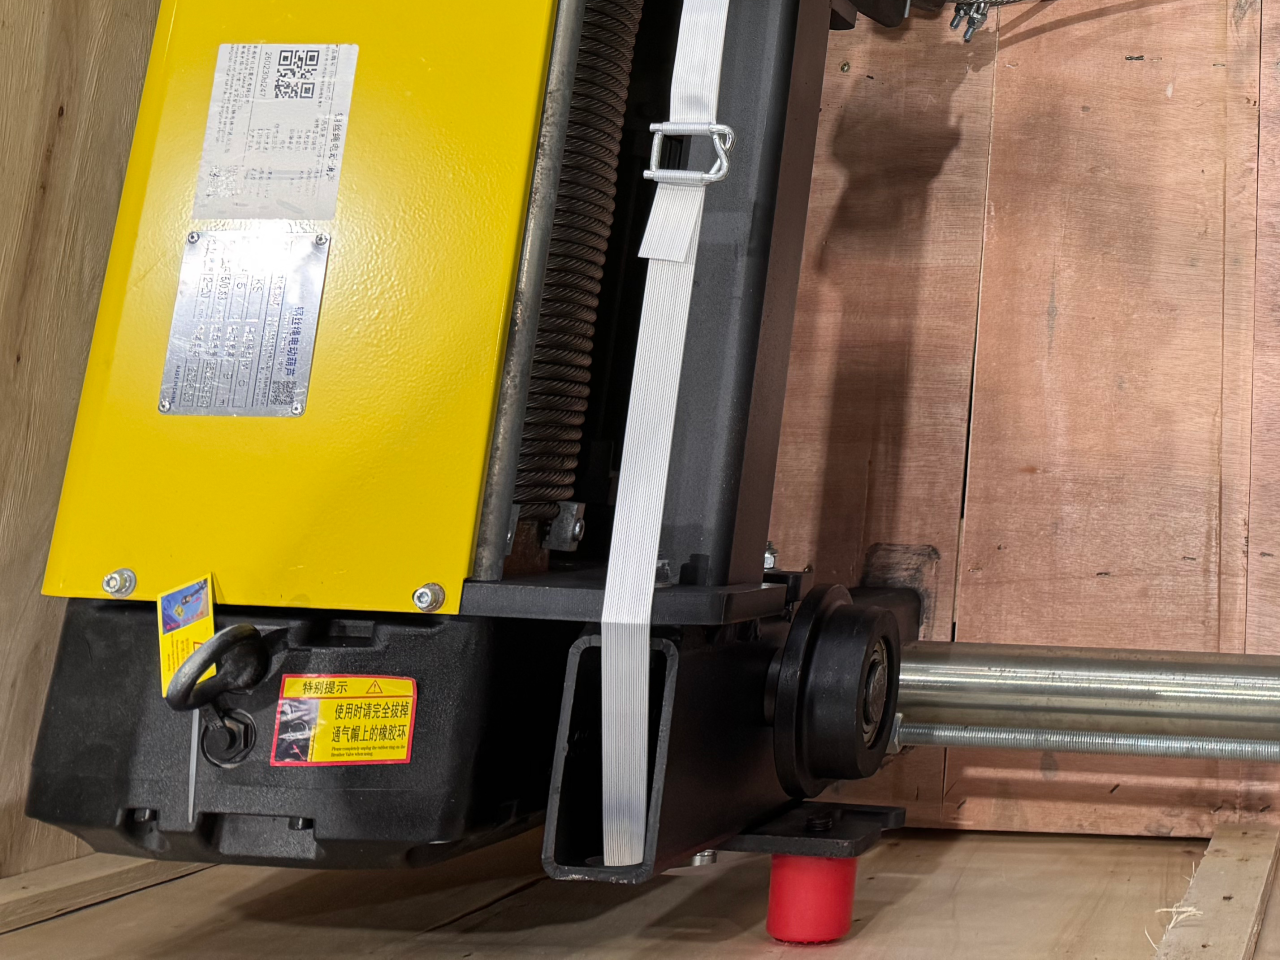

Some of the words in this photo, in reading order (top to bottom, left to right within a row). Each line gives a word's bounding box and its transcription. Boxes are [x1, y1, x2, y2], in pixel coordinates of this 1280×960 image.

[286, 306, 304, 377] 钢丝绳电动葫芦
[302, 680, 348, 694] 特别提示
[335, 701, 410, 720] 使用时请完全拔掉
[331, 724, 407, 742] 通气帽上的橡胶环
